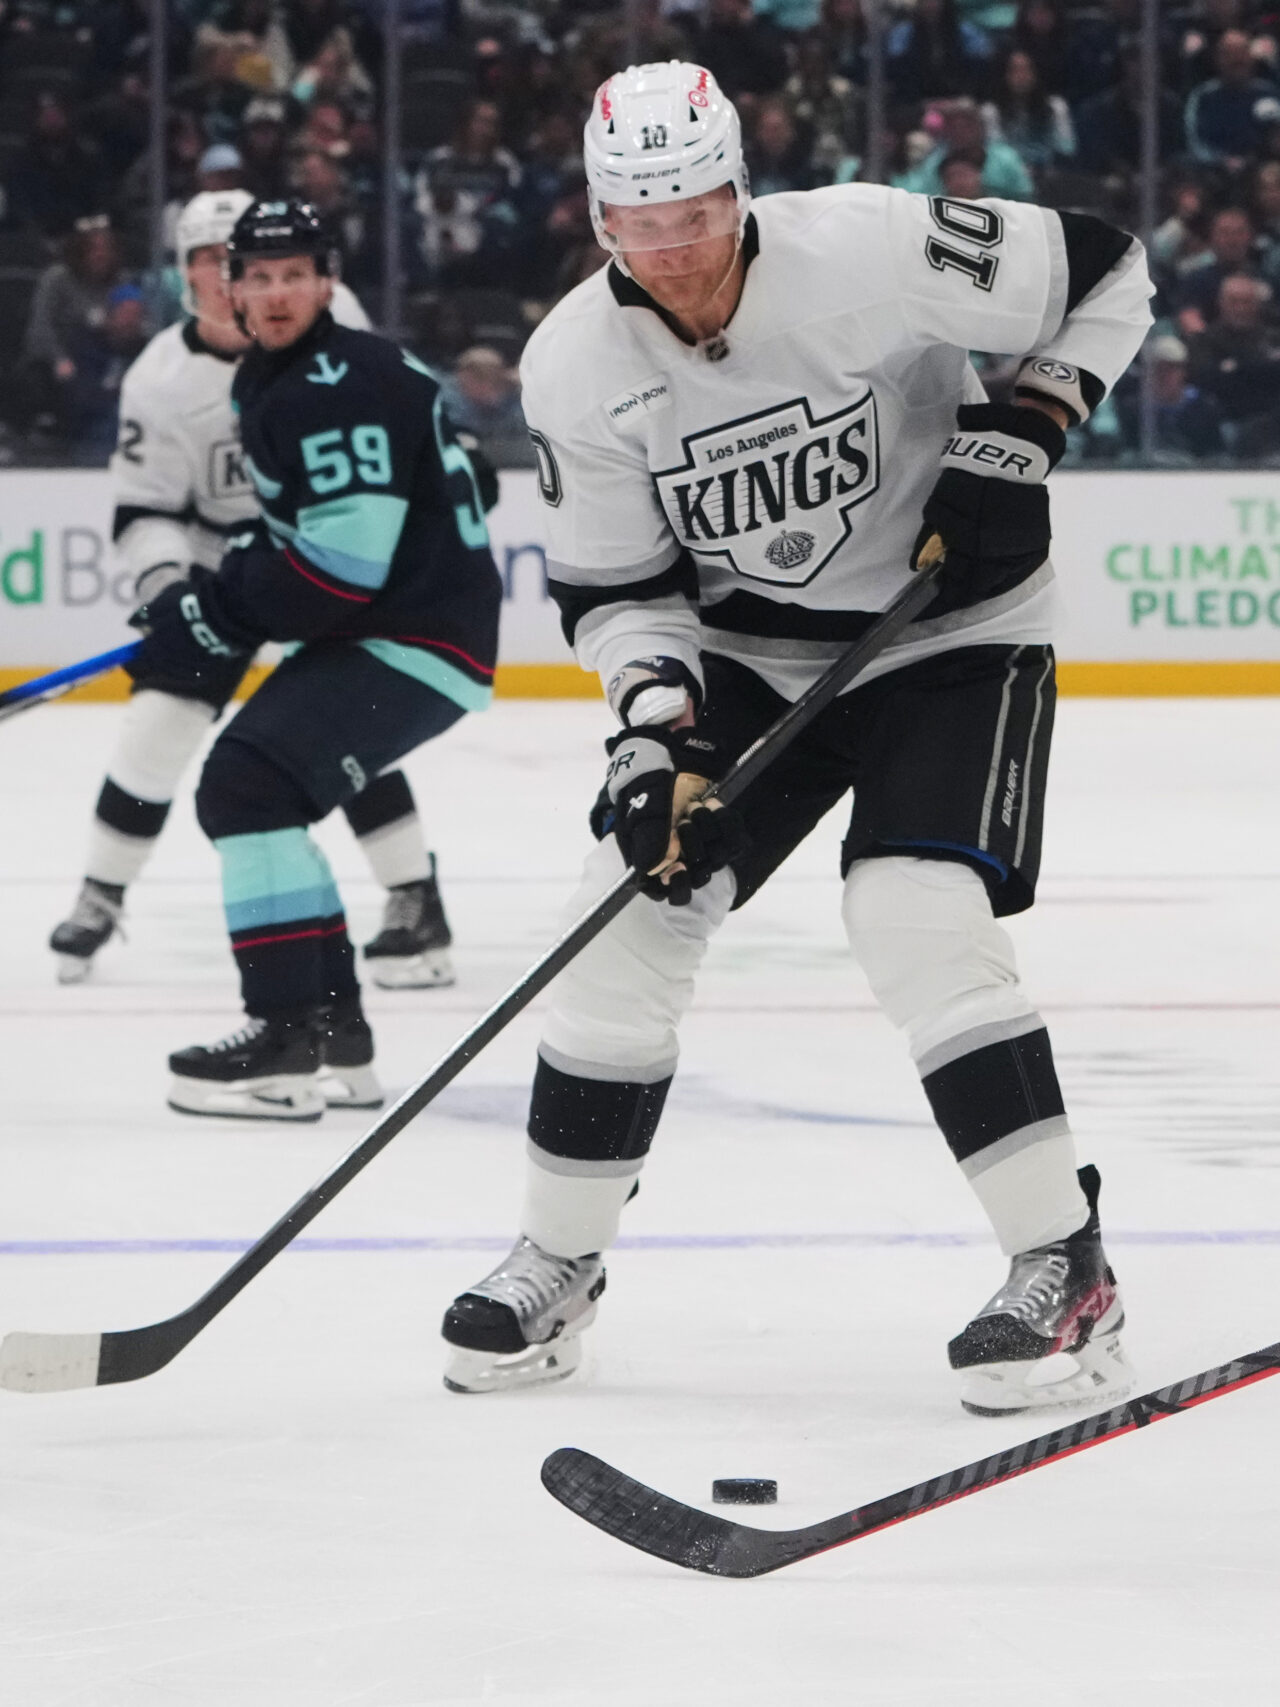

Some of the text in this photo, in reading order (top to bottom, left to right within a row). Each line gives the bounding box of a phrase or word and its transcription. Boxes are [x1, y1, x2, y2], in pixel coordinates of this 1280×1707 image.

[641, 124, 668, 150] 10
[925, 196, 1004, 293] 10
[609, 384, 668, 419] IRON BOW
[300, 424, 392, 494] 59
[705, 423, 798, 464] Los Angeles
[672, 417, 869, 541] KINGS
[1001, 758, 1018, 828] BAUER
